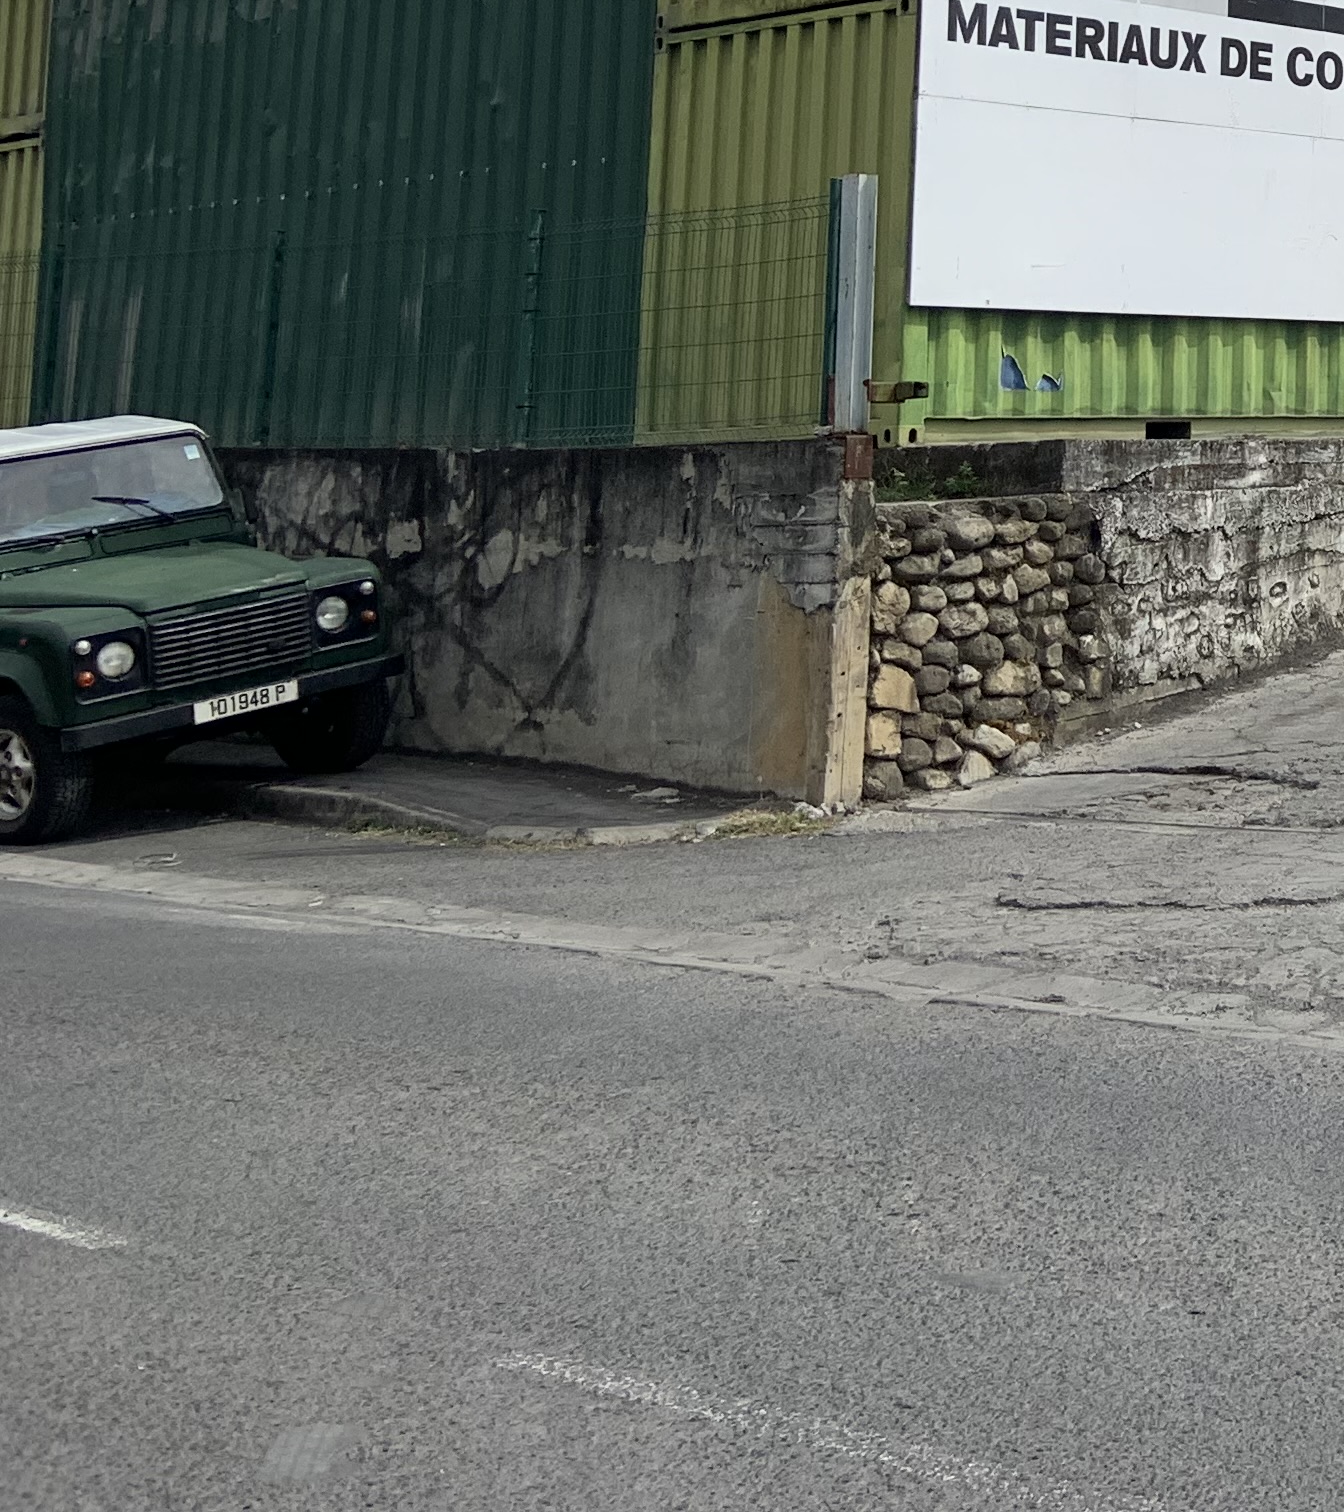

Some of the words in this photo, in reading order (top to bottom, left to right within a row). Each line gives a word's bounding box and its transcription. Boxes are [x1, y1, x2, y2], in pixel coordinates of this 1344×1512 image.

[947, 0, 1206, 74] MATERIAUX
[1220, 37, 1273, 82] DE
[275, 684, 285, 702] P
